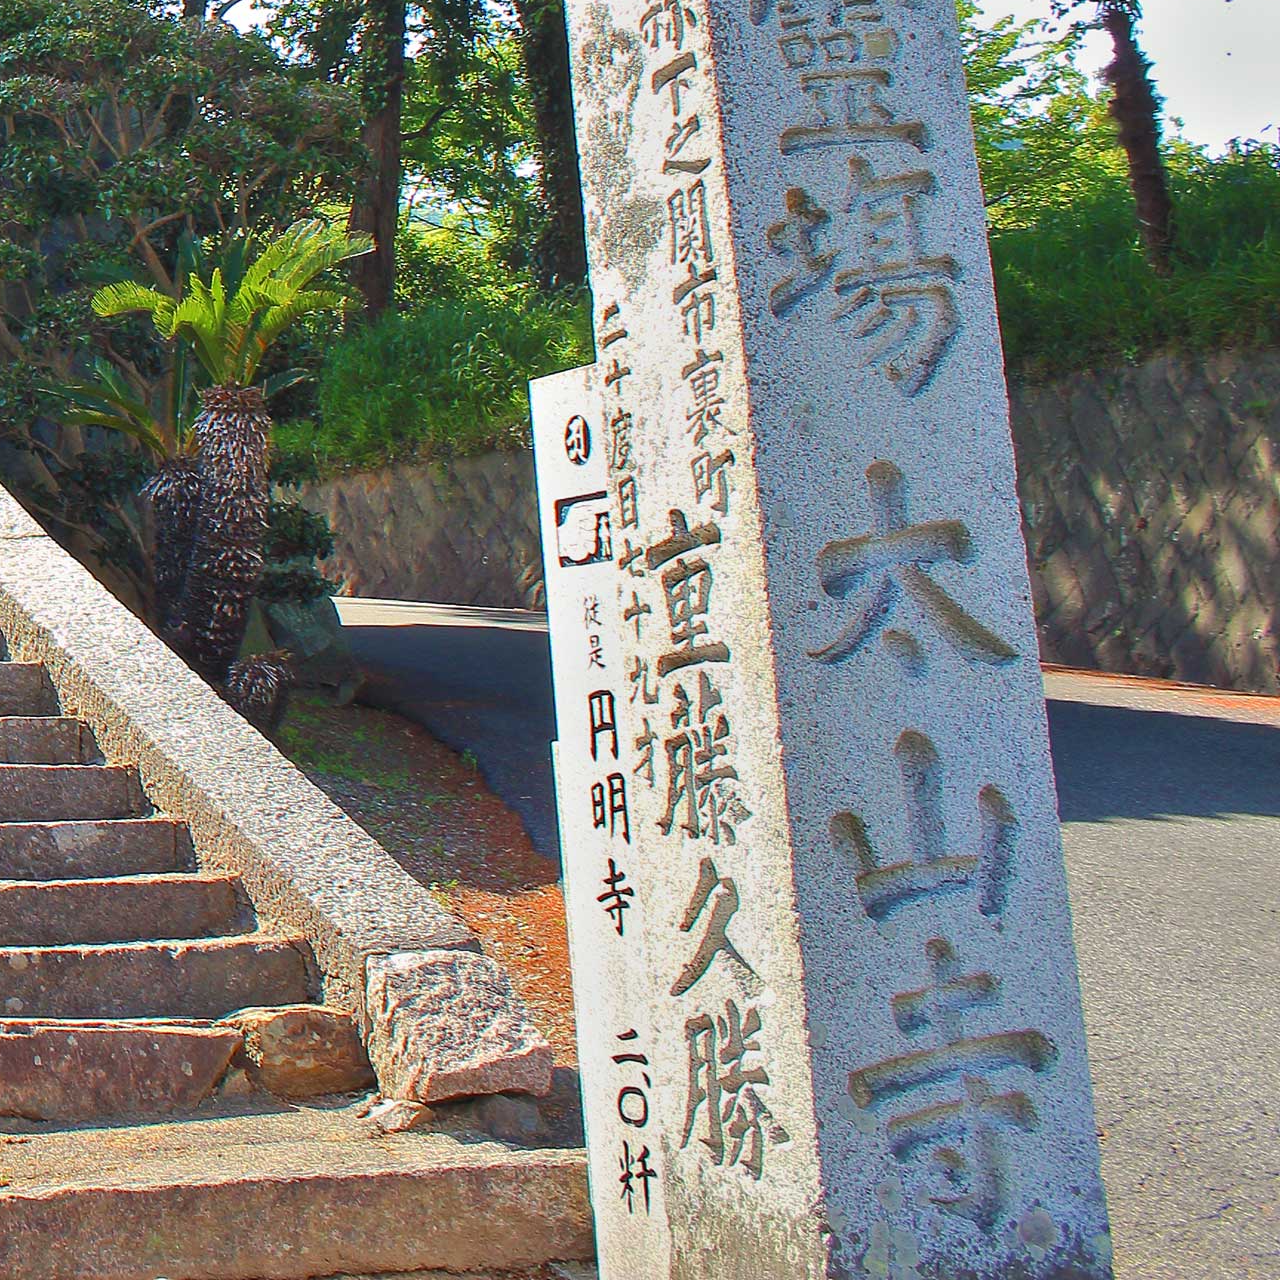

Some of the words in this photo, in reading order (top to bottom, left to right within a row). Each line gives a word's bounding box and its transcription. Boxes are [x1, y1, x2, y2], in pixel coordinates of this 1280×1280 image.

[587, 689, 634, 936] 円明寺
[807, 459, 1058, 1233] 太山寺
